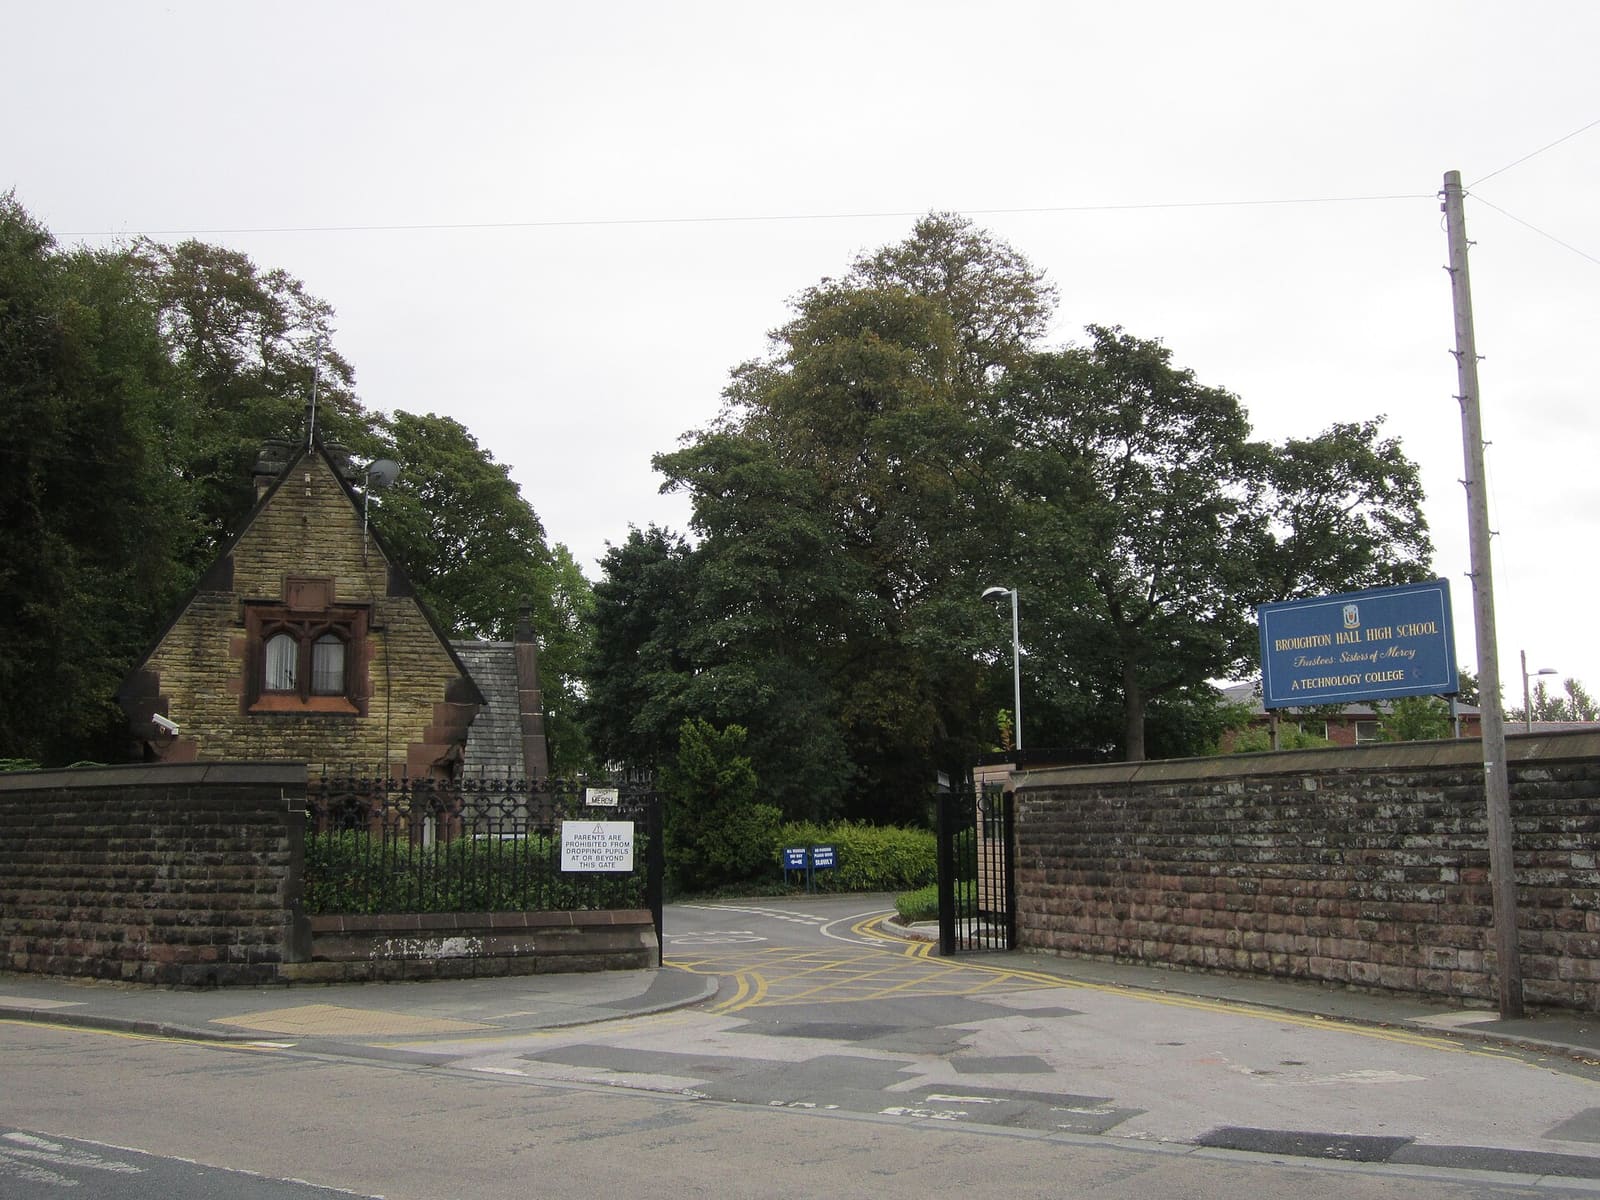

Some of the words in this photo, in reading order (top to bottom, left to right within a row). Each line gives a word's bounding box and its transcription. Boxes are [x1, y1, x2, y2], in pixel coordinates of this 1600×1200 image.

[1275, 634, 1331, 651] BROUGHTON
[1336, 631, 1362, 644] HALL
[1366, 627, 1392, 641] HIGH
[1397, 621, 1438, 637] SCHOOL
[1339, 651, 1368, 663] Sisters
[1369, 650, 1379, 663] of
[1380, 645, 1416, 660] Mercy
[1291, 680, 1300, 691] A
[1301, 673, 1362, 689] TECHNOLOGY
[1365, 669, 1405, 682] COLLEGE
[591, 796, 613, 804] MERCY
